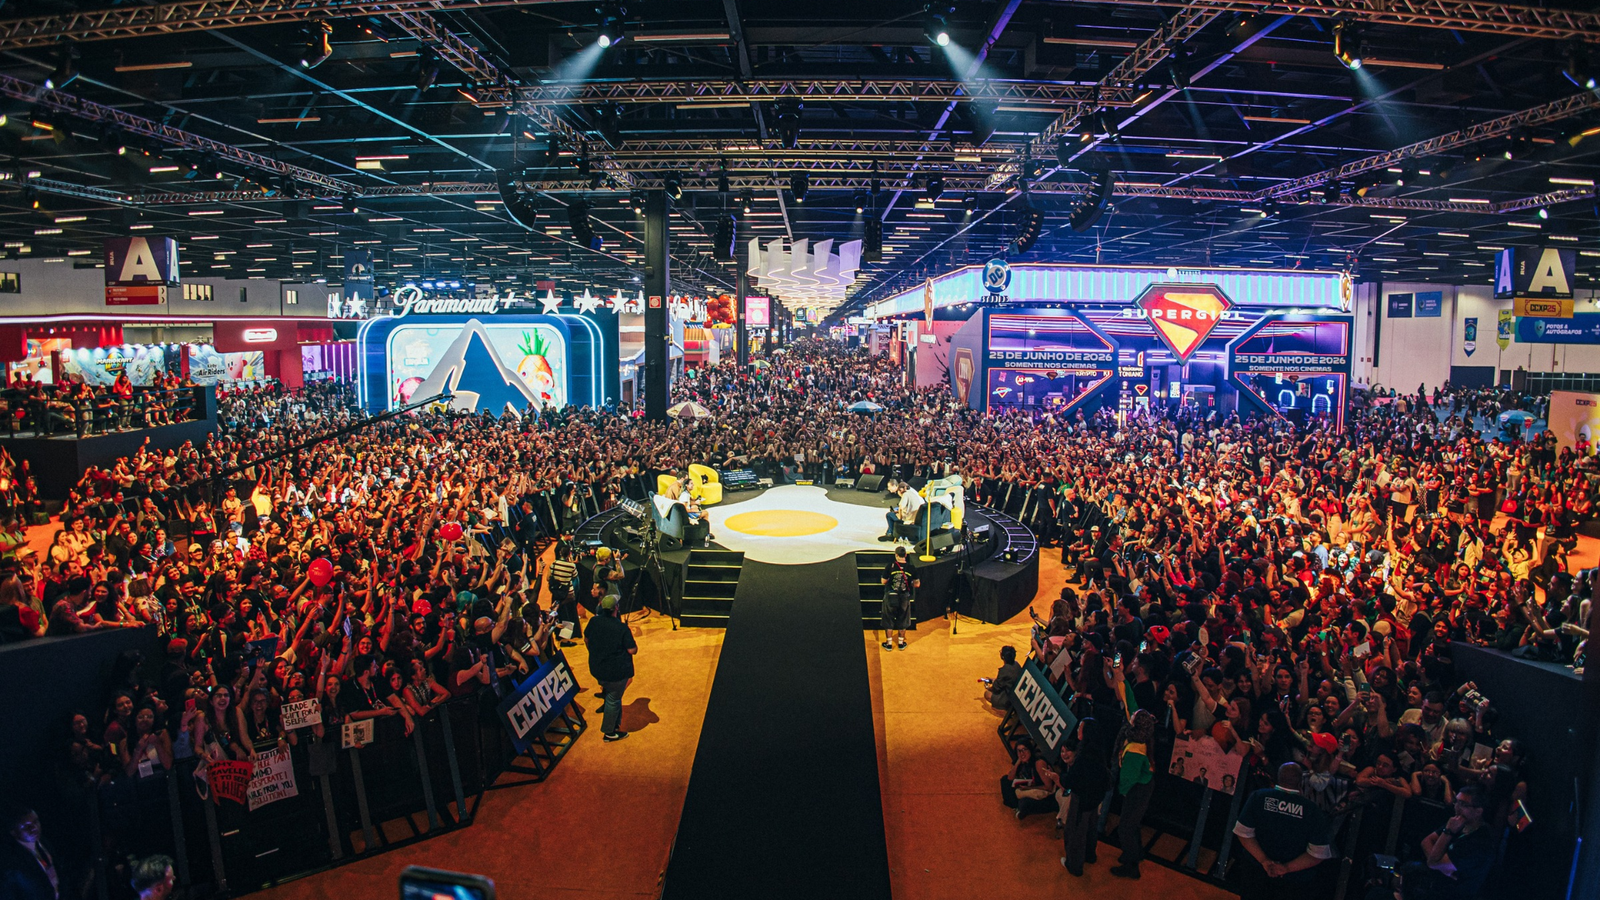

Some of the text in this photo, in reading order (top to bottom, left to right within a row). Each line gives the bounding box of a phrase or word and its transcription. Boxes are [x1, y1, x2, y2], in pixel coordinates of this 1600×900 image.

[119, 237, 162, 281] A
[988, 268, 1003, 285] DC
[1497, 249, 1512, 293] A
[1528, 248, 1570, 293] A
[389, 286, 522, 318] Paramount+
[1530, 304, 1556, 313] CCXP25
[1122, 308, 1245, 322] SUPERGIRL
[989, 351, 1113, 361] 25 DE JUNHO DE 2026
[1235, 355, 1346, 365] 25 DE JUNHO DE 2026
[1004, 361, 1043, 369] SOMENTE
[282, 701, 308, 713] TRADE
[506, 661, 574, 739] CCXP25
[286, 711, 300, 719] GIFT
[302, 708, 313, 717] FOR
[1014, 669, 1067, 750] CCXP25
[286, 718, 308, 726] SELFIE
[281, 779, 293, 789] YOU
[1278, 801, 1303, 816] CAVA
